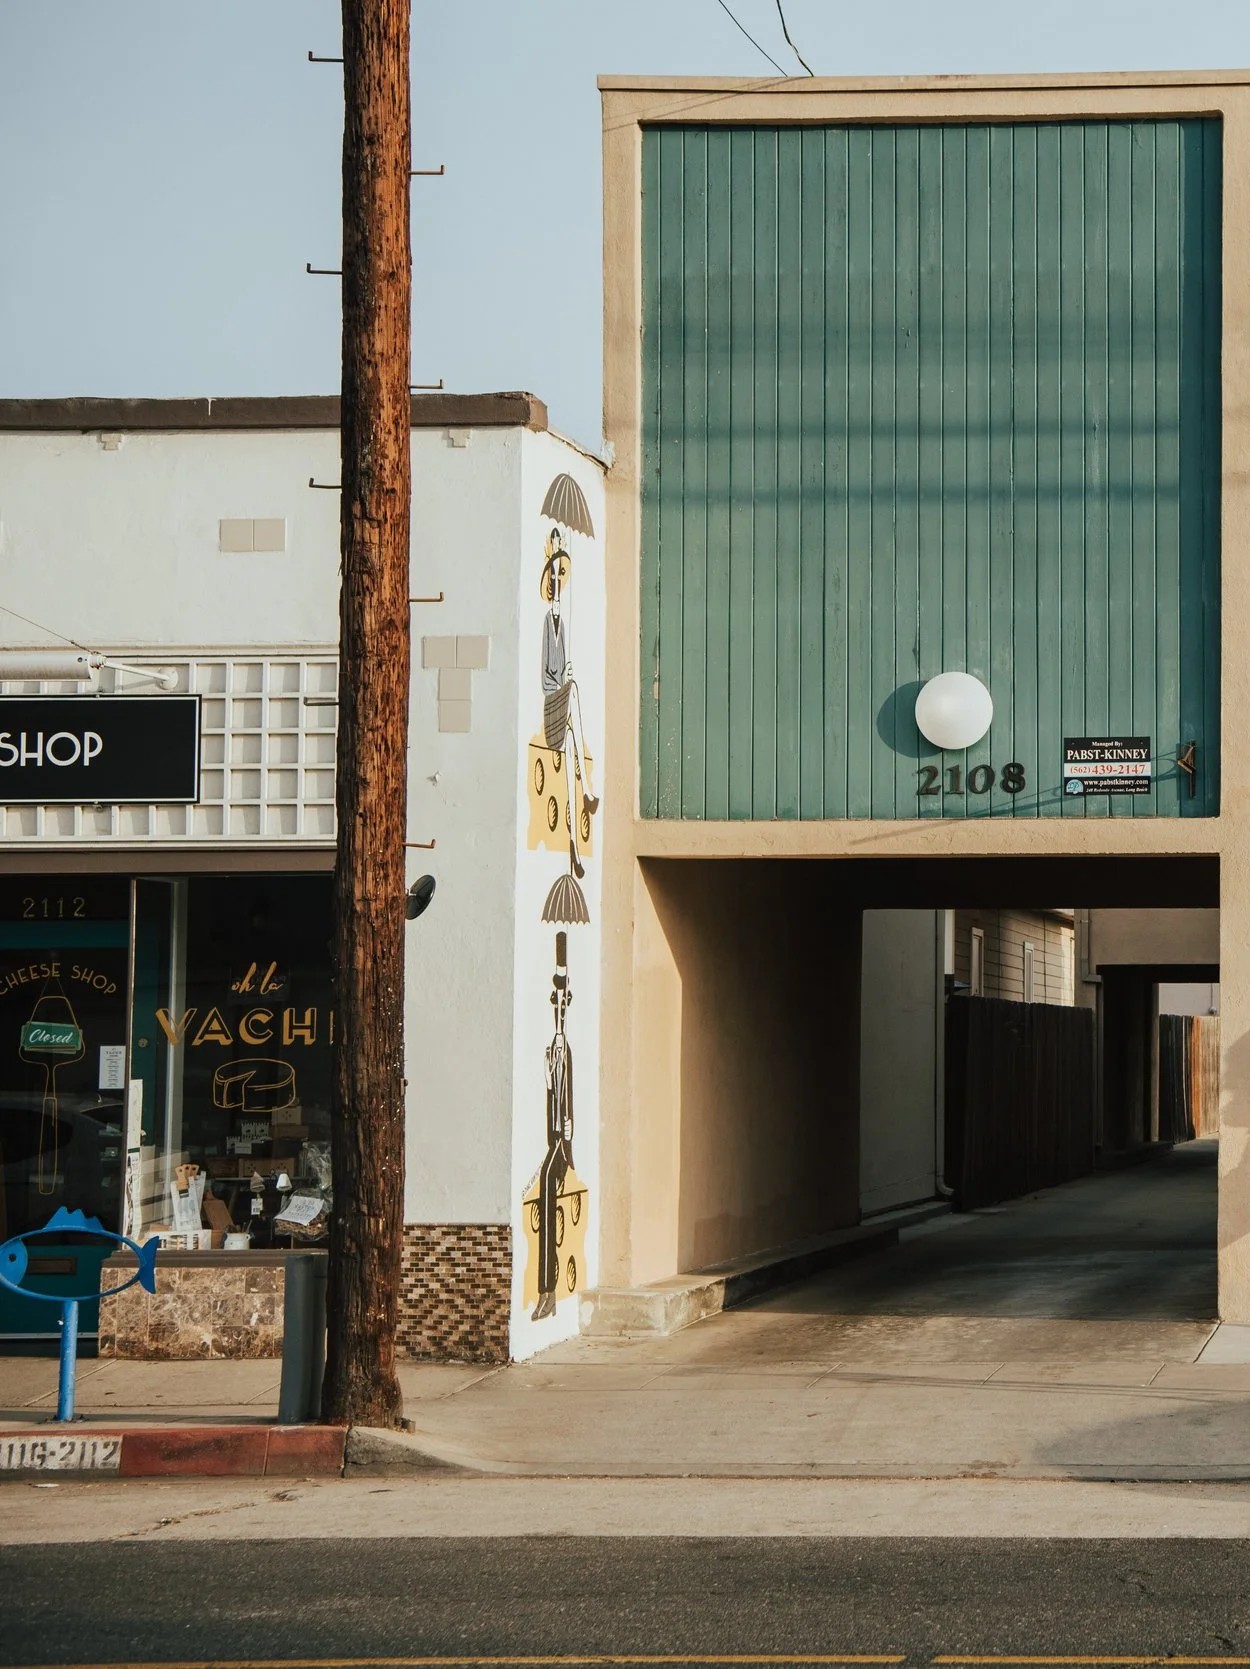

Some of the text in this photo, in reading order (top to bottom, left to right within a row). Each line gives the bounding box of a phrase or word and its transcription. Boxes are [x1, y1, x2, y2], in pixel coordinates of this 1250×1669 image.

[0, 731, 103, 767] SHOP
[1066, 748, 1148, 760] PABST-KINNEY
[916, 761, 1026, 796] 2108
[1070, 764, 1146, 775] (562) 439-2147
[1083, 778, 1149, 788] www.pabstkinney.com
[22, 897, 87, 918] 2112
[71, 965, 117, 994] SHOP
[231, 960, 285, 995] oh la
[29, 1028, 74, 1045] Closed
[155, 1007, 335, 1046] VACH
